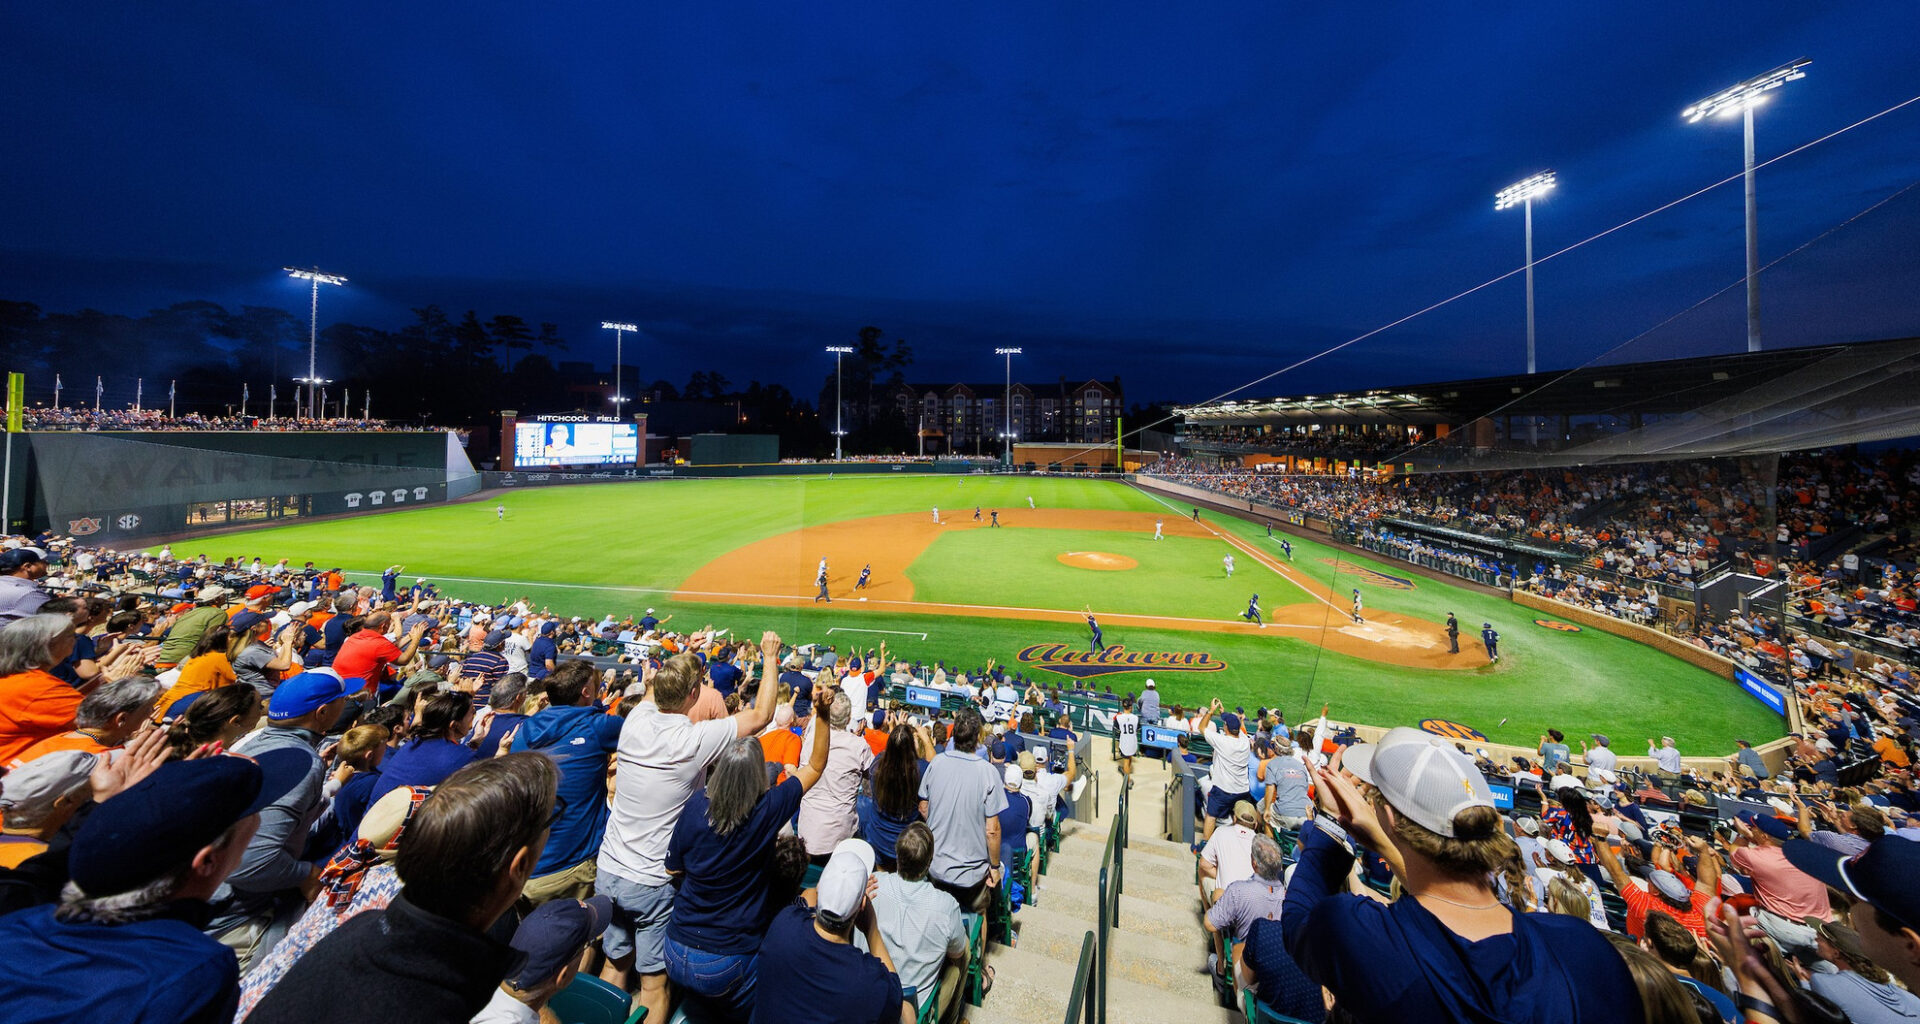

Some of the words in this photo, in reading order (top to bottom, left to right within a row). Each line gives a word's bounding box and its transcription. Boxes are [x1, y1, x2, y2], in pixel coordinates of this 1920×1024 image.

[537, 414, 589, 422] HITCHCOCK
[596, 415, 620, 423] FIELD
[82, 458, 247, 492] WAR
[269, 452, 419, 480] EAGLE
[118, 514, 140, 529] SEC
[1016, 643, 1220, 668] Auburn
[917, 693, 938, 702] BASEBALL
[1123, 723, 1134, 734] 18
[1422, 720, 1485, 742] SEC
